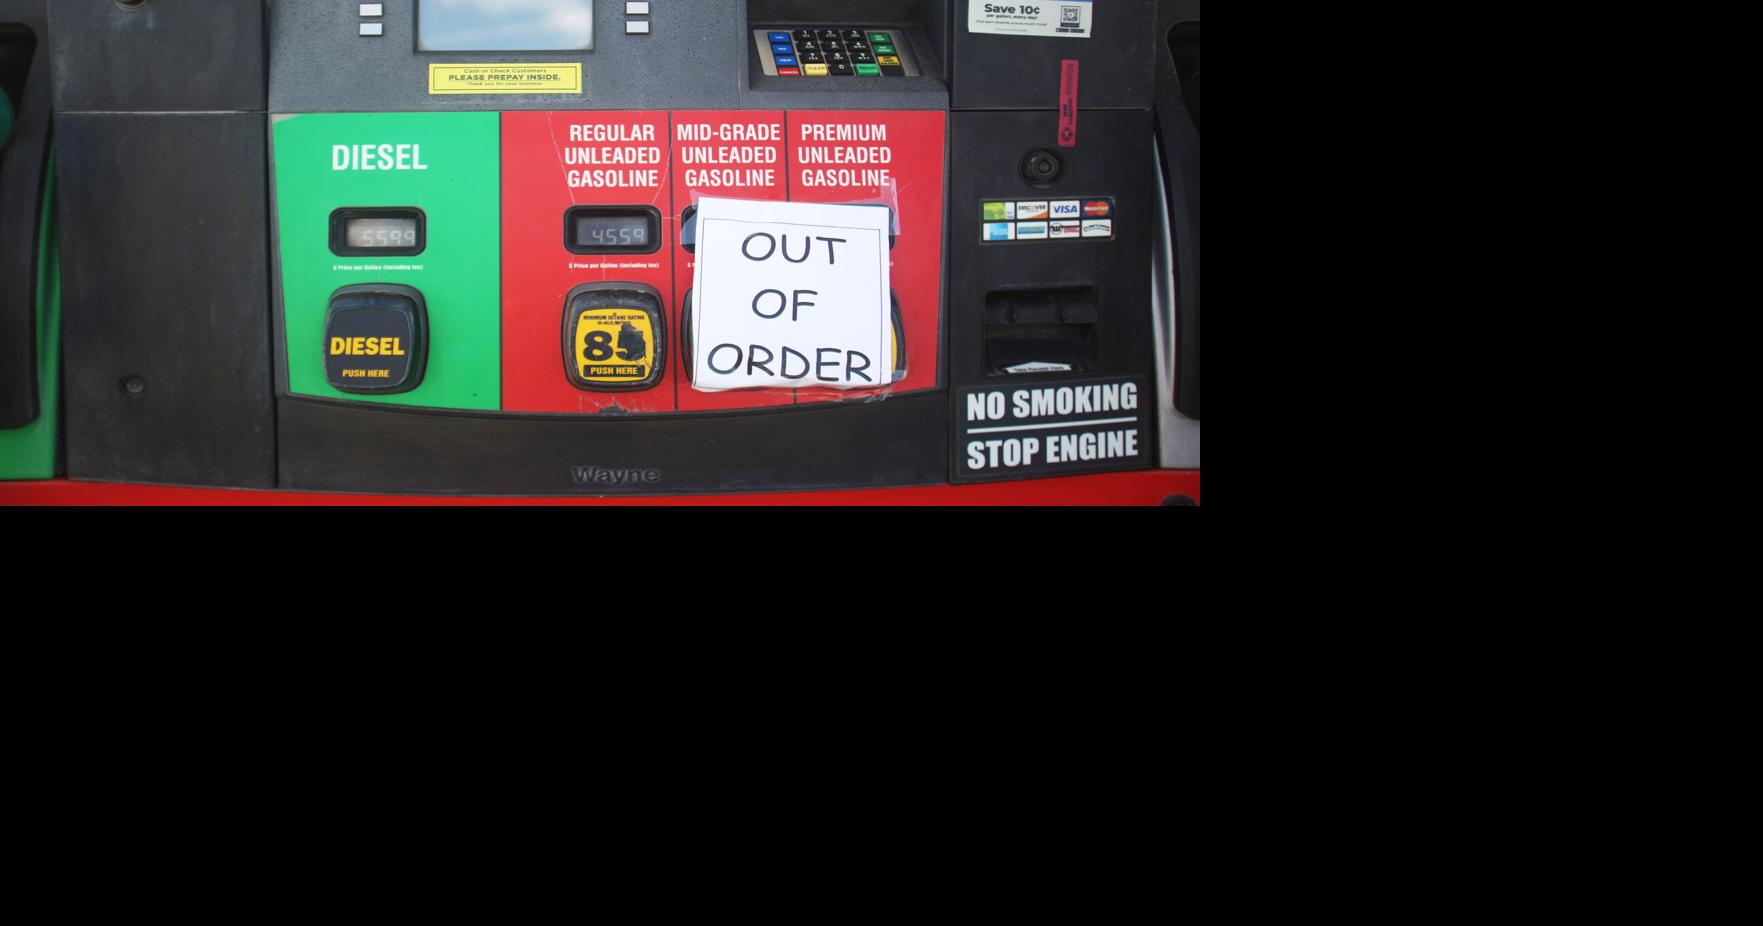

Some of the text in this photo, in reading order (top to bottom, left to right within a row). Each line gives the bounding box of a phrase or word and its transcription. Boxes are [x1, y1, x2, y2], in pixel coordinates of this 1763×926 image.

[984, 3, 1041, 15] Save 10¢
[569, 124, 655, 142] REGULAR
[677, 123, 780, 142] MID-GRADE
[801, 123, 886, 142] PREMIUM
[332, 144, 428, 170] DIESEL
[564, 147, 660, 165] UNLEADED
[682, 146, 777, 164] UNLEADED
[798, 146, 892, 164] UNLEADED
[567, 169, 658, 188] GASOLINE
[685, 169, 775, 187] GASOLINE
[801, 169, 890, 187] GASOLINE
[1054, 205, 1078, 213] VISA
[592, 228, 645, 245] 4559
[741, 232, 847, 265] OUT
[752, 288, 818, 322] OF
[330, 336, 405, 356] DIESEL
[590, 367, 638, 375] PUSH HERE
[707, 343, 873, 382] ORDER
[342, 369, 390, 378] PUSH HERE
[967, 382, 1138, 421] NO SMOKING
[967, 429, 1138, 470] STOP ENGINE
[569, 464, 660, 486] Wayne
